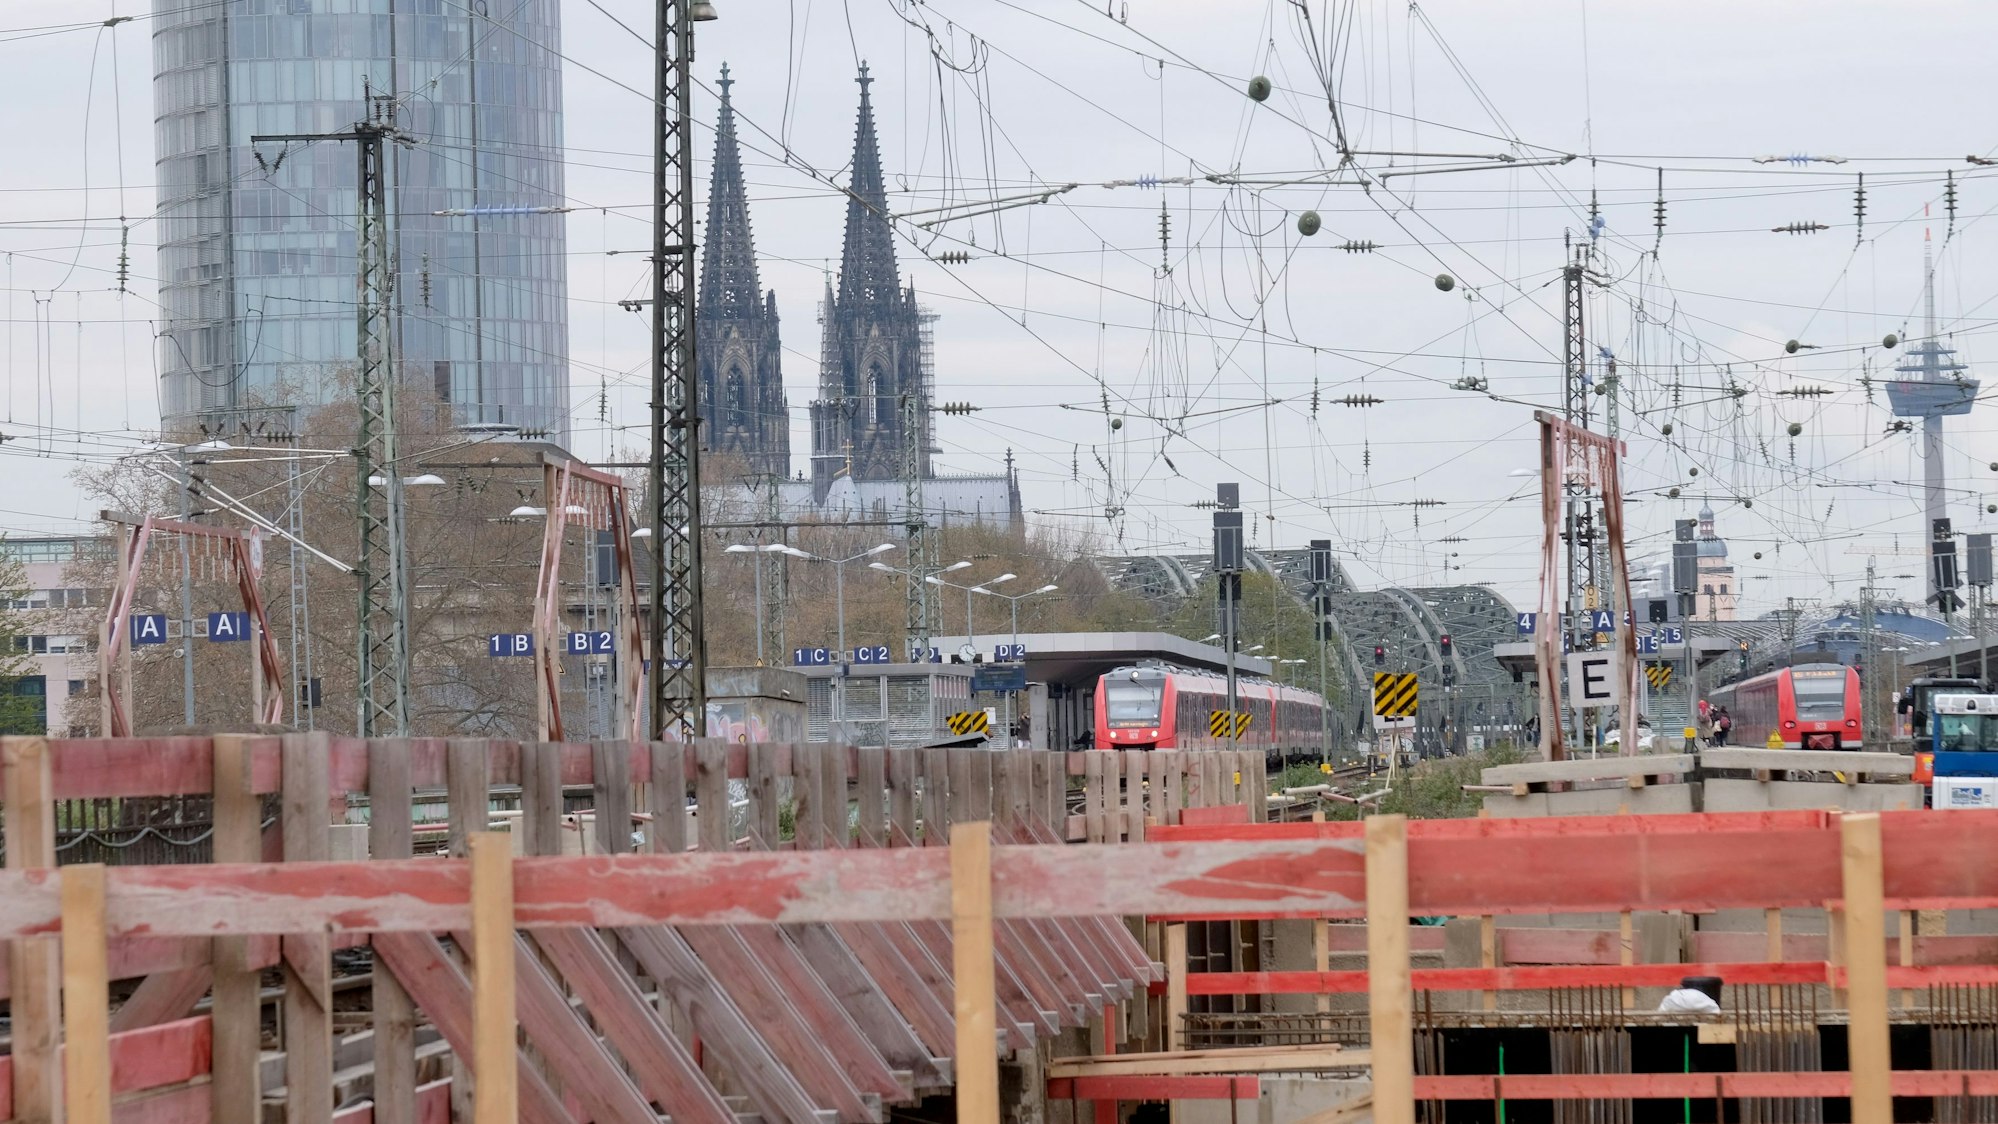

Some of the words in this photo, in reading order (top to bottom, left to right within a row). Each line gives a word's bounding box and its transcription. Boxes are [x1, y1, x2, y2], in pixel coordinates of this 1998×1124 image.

[140, 616, 160, 638] A
[215, 613, 234, 636] A
[1519, 613, 1531, 630] 4
[1597, 611, 1612, 628] A
[491, 636, 500, 652] 1
[515, 634, 529, 651] B
[574, 633, 588, 650] B
[599, 631, 612, 650] 2
[1673, 628, 1681, 641] 5
[795, 649, 803, 663] 1
[813, 648, 825, 663] C
[858, 647, 871, 661] C
[878, 646, 889, 661] 2
[1000, 645, 1009, 657] D
[1016, 644, 1025, 656] 2
[1581, 658, 1611, 700] E
